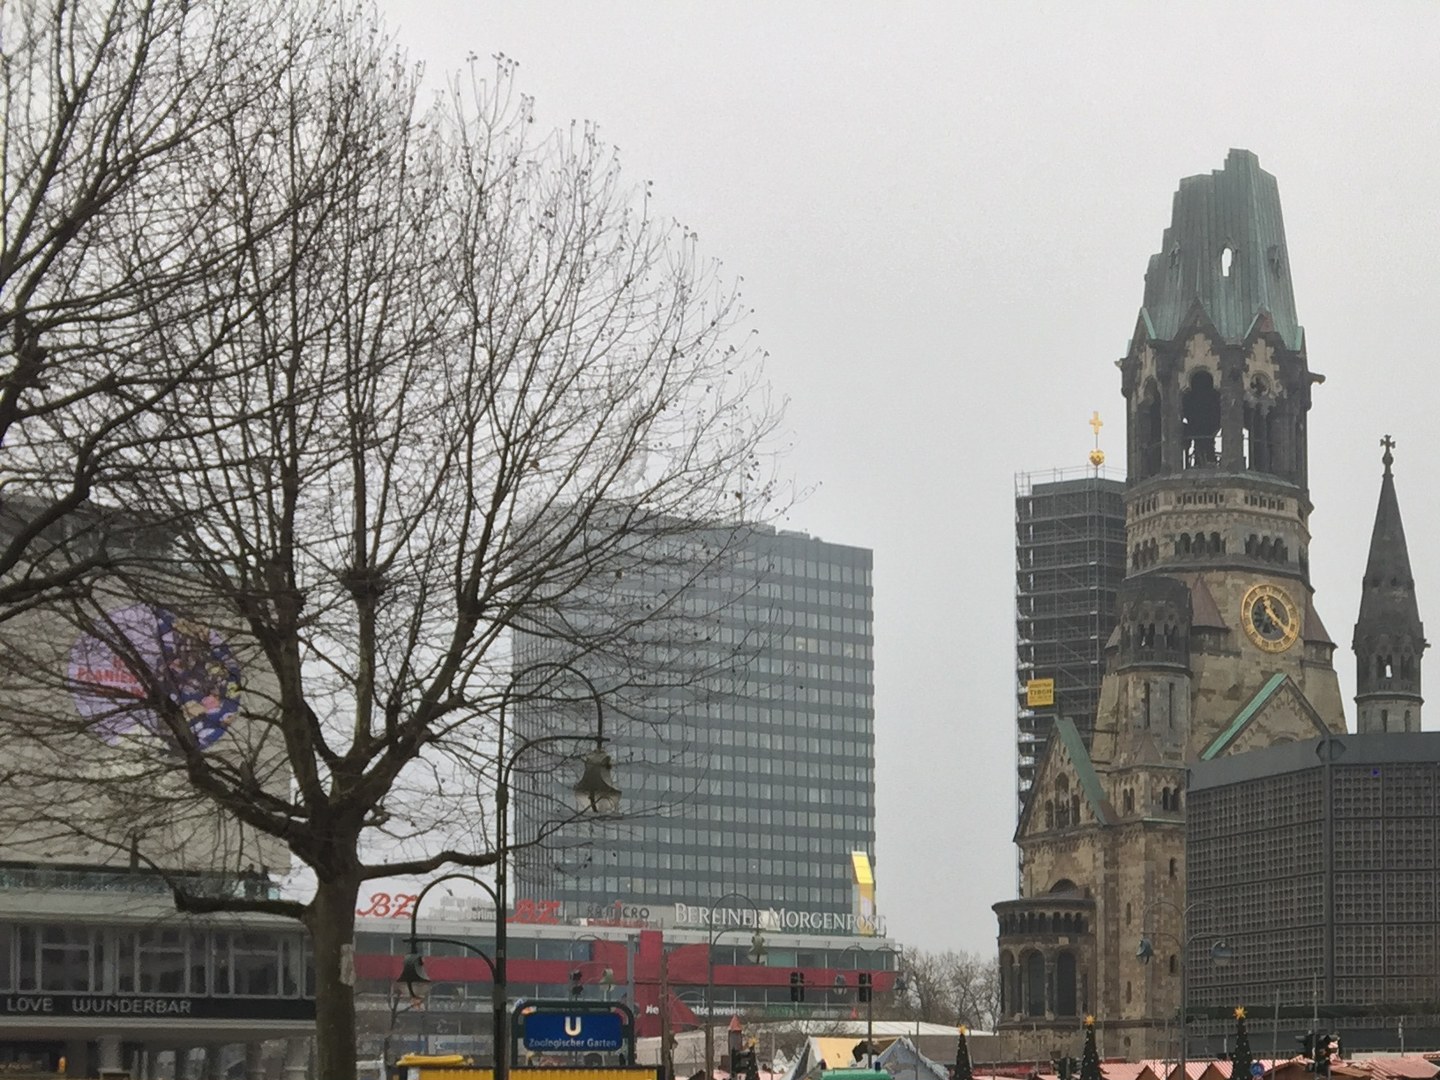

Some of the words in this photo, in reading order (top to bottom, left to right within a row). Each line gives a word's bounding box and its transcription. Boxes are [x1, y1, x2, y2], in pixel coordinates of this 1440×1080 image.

[675, 902, 764, 929] BERLINER
[769, 906, 887, 933] MORGENPOST
[7, 997, 54, 1012] LOVE
[71, 998, 192, 1013] WUNDERBAR
[564, 1016, 582, 1037] U
[528, 1038, 585, 1049] Zoologischer
[586, 1038, 617, 1048] Garten
